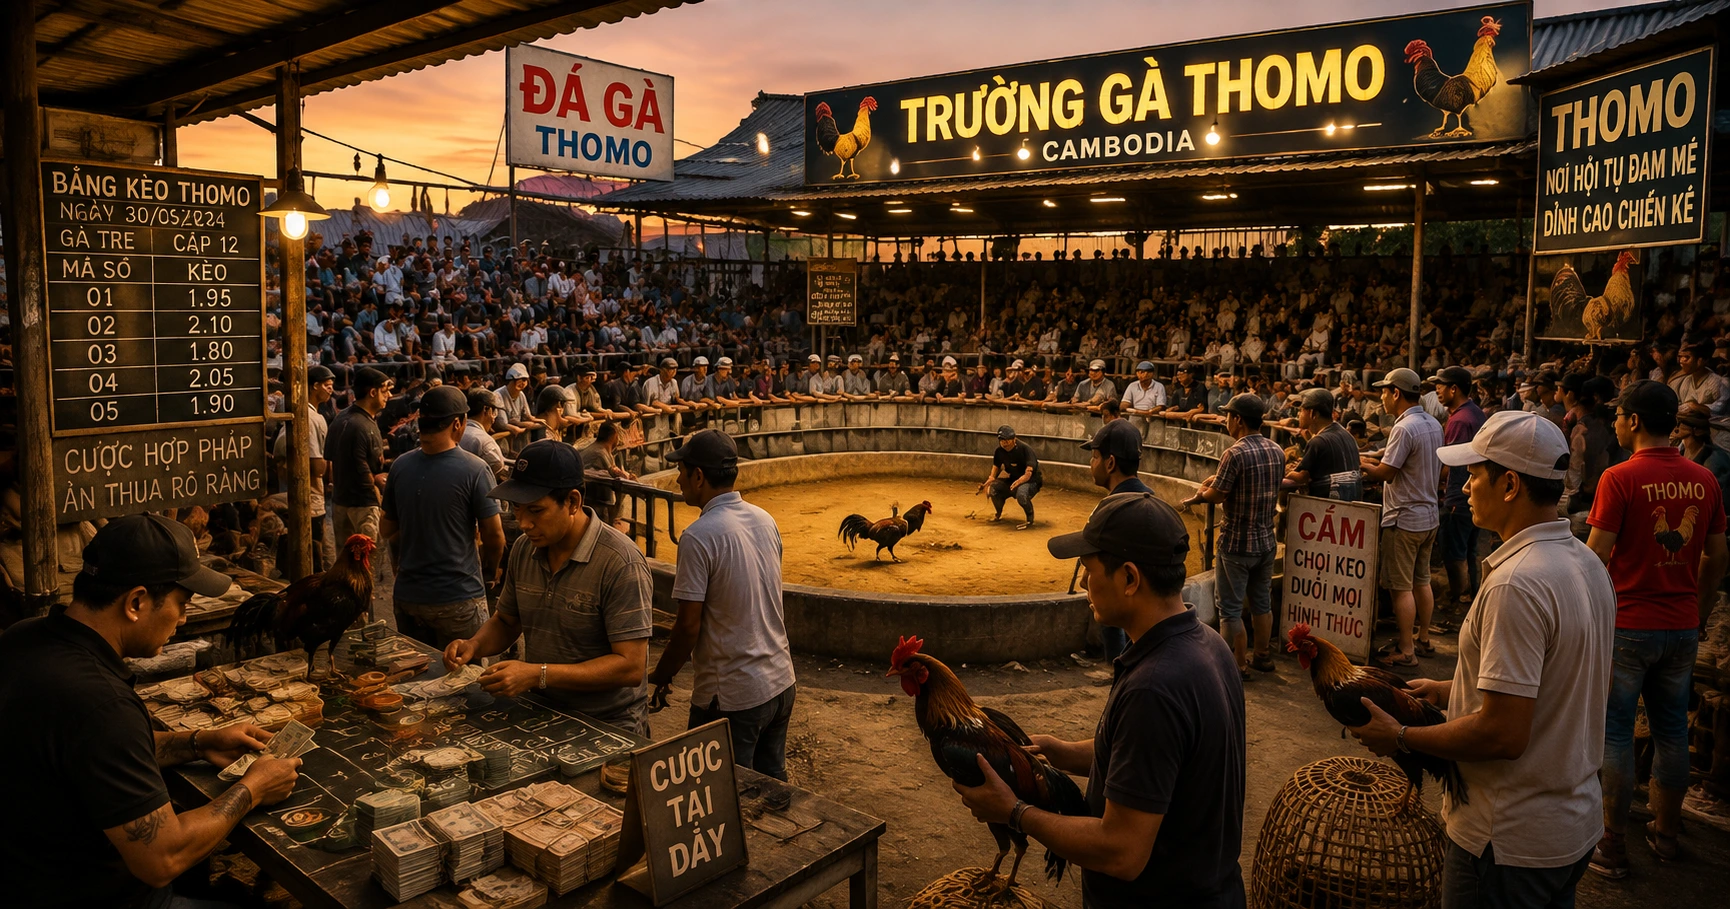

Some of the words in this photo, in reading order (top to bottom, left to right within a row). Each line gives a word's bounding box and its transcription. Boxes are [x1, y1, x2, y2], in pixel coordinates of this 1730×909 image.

[520, 63, 591, 122] ĐÁ
[603, 78, 664, 134] GÀ
[900, 75, 1084, 143] TRƯỜNG
[1099, 56, 1172, 125] GÀ
[1184, 44, 1385, 116] THOMO
[1551, 71, 1696, 152] THOMO
[535, 125, 652, 168] THOMO
[1042, 129, 1195, 162] CAMBODIA
[1628, 148, 1666, 184] ĐAM
[178, 181, 250, 206] THOMO
[1582, 202, 1613, 233] CAO
[61, 226, 90, 248] GÀ
[97, 230, 135, 249] TRE
[220, 236, 239, 253] 12
[188, 260, 227, 281] KÈO
[87, 287, 112, 306] 01
[188, 288, 231, 307] 1.95
[87, 315, 115, 335] 02
[188, 315, 232, 333] 2.10
[88, 343, 116, 364] 03
[190, 341, 233, 361] 1.80
[89, 372, 118, 393] 04
[189, 368, 234, 388] 2.05
[90, 401, 118, 421] 05
[190, 394, 234, 415] 1.90
[1642, 481, 1705, 502] THOMO
[1335, 555, 1365, 579] KEO
[650, 740, 722, 792] CƯỢC
